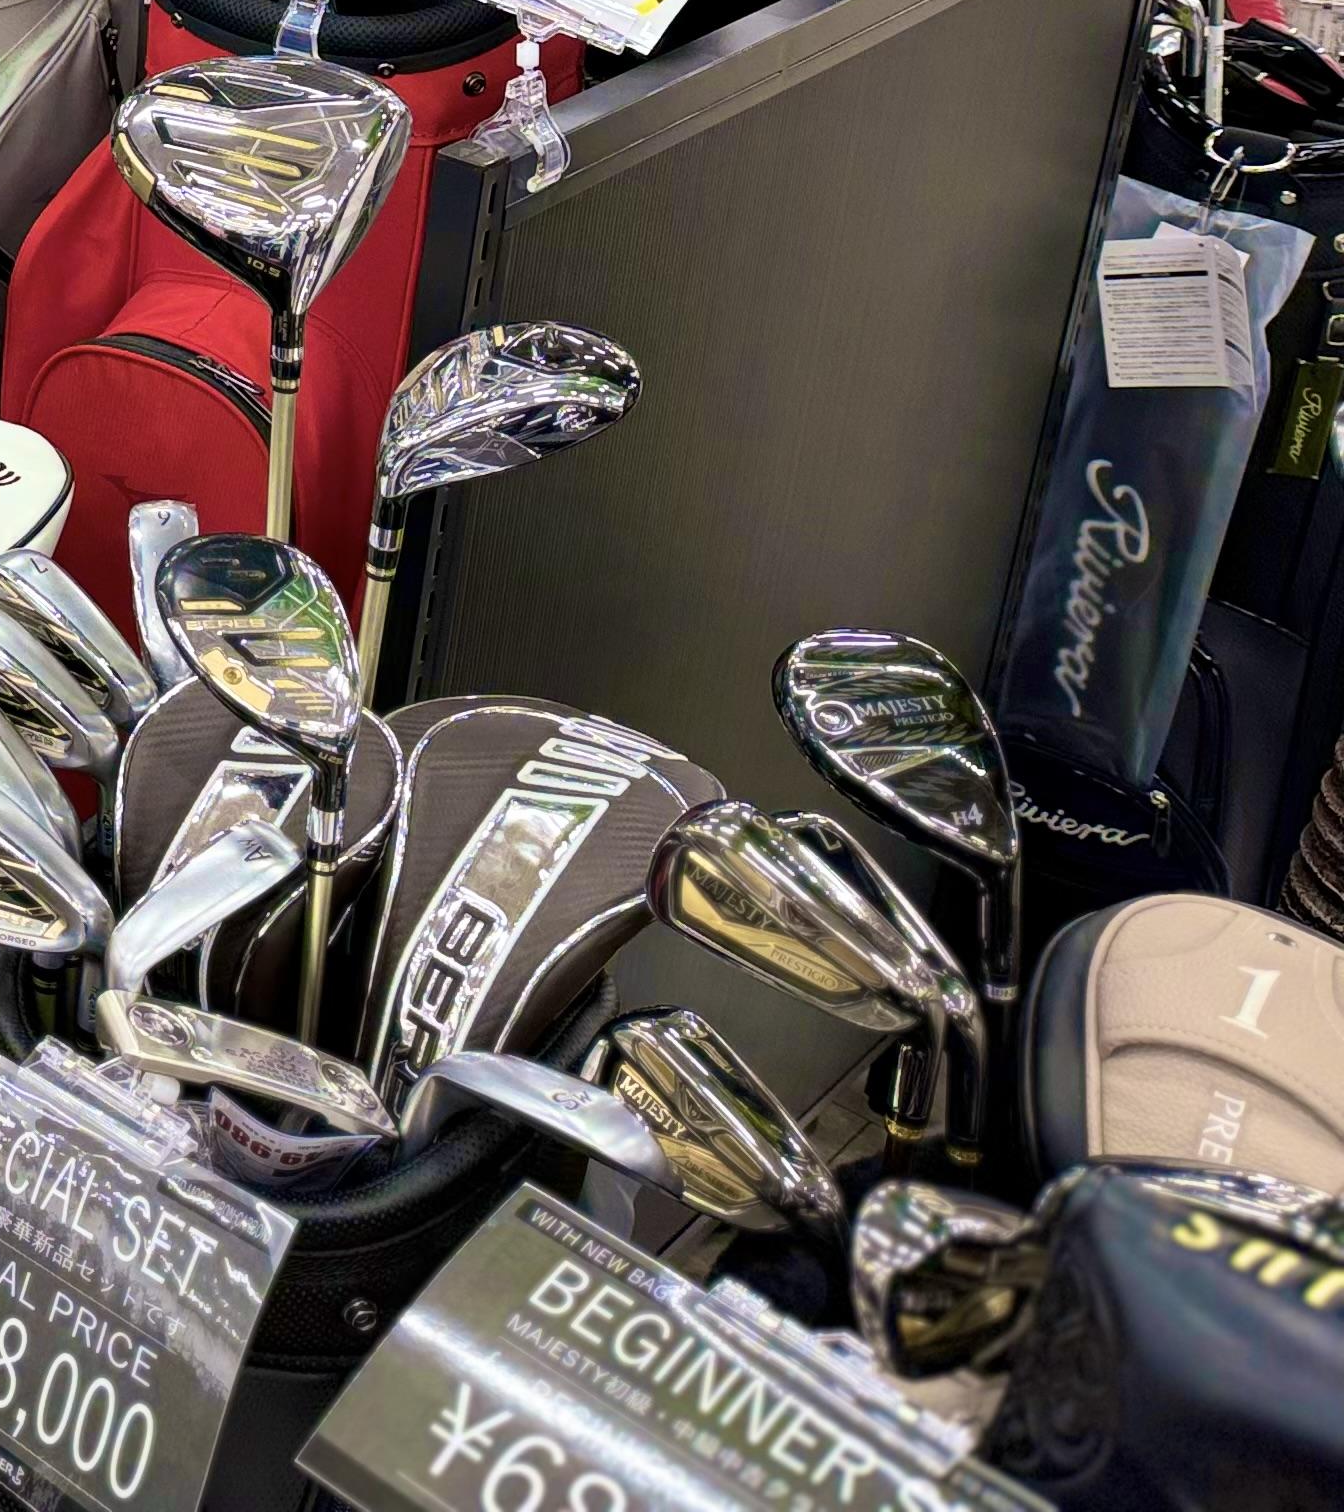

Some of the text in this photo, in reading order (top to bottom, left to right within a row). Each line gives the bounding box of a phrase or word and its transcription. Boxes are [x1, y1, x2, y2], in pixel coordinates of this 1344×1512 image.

[243, 254, 282, 280] 10.5
[1288, 386, 1325, 466] Riviera
[1054, 458, 1151, 719] Riviera
[951, 802, 984, 826] H4
[688, 866, 774, 930] MAJESTY
[771, 948, 840, 990] PRESTIGIO
[1218, 964, 1284, 1039] 1
[618, 1075, 687, 1138] MAJESTY
[113, 1194, 219, 1296] SET
[530, 1207, 582, 1246] WITH
[581, 1242, 630, 1274] NEW
[48, 1289, 159, 1390] PRICE
[528, 1259, 879, 1504] BEGINNER
